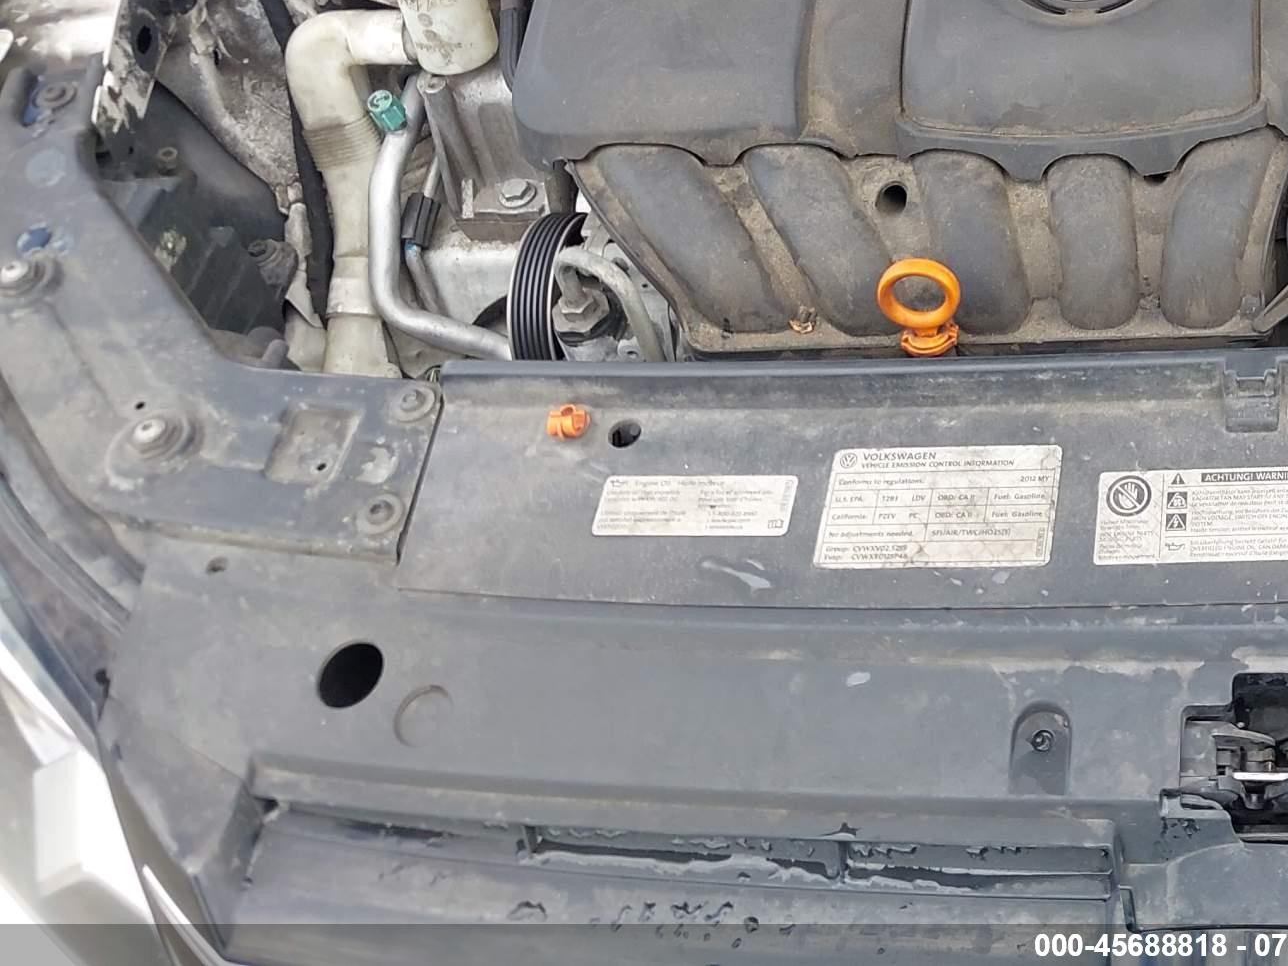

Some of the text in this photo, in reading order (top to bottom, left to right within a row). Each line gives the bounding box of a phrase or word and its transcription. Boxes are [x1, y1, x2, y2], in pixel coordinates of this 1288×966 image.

[863, 451, 936, 462] VOLKSWAGEN
[1204, 472, 1253, 482] ACHTUNG!
[1014, 492, 1045, 500] Gasoline
[1011, 510, 1042, 518] Gasoline
